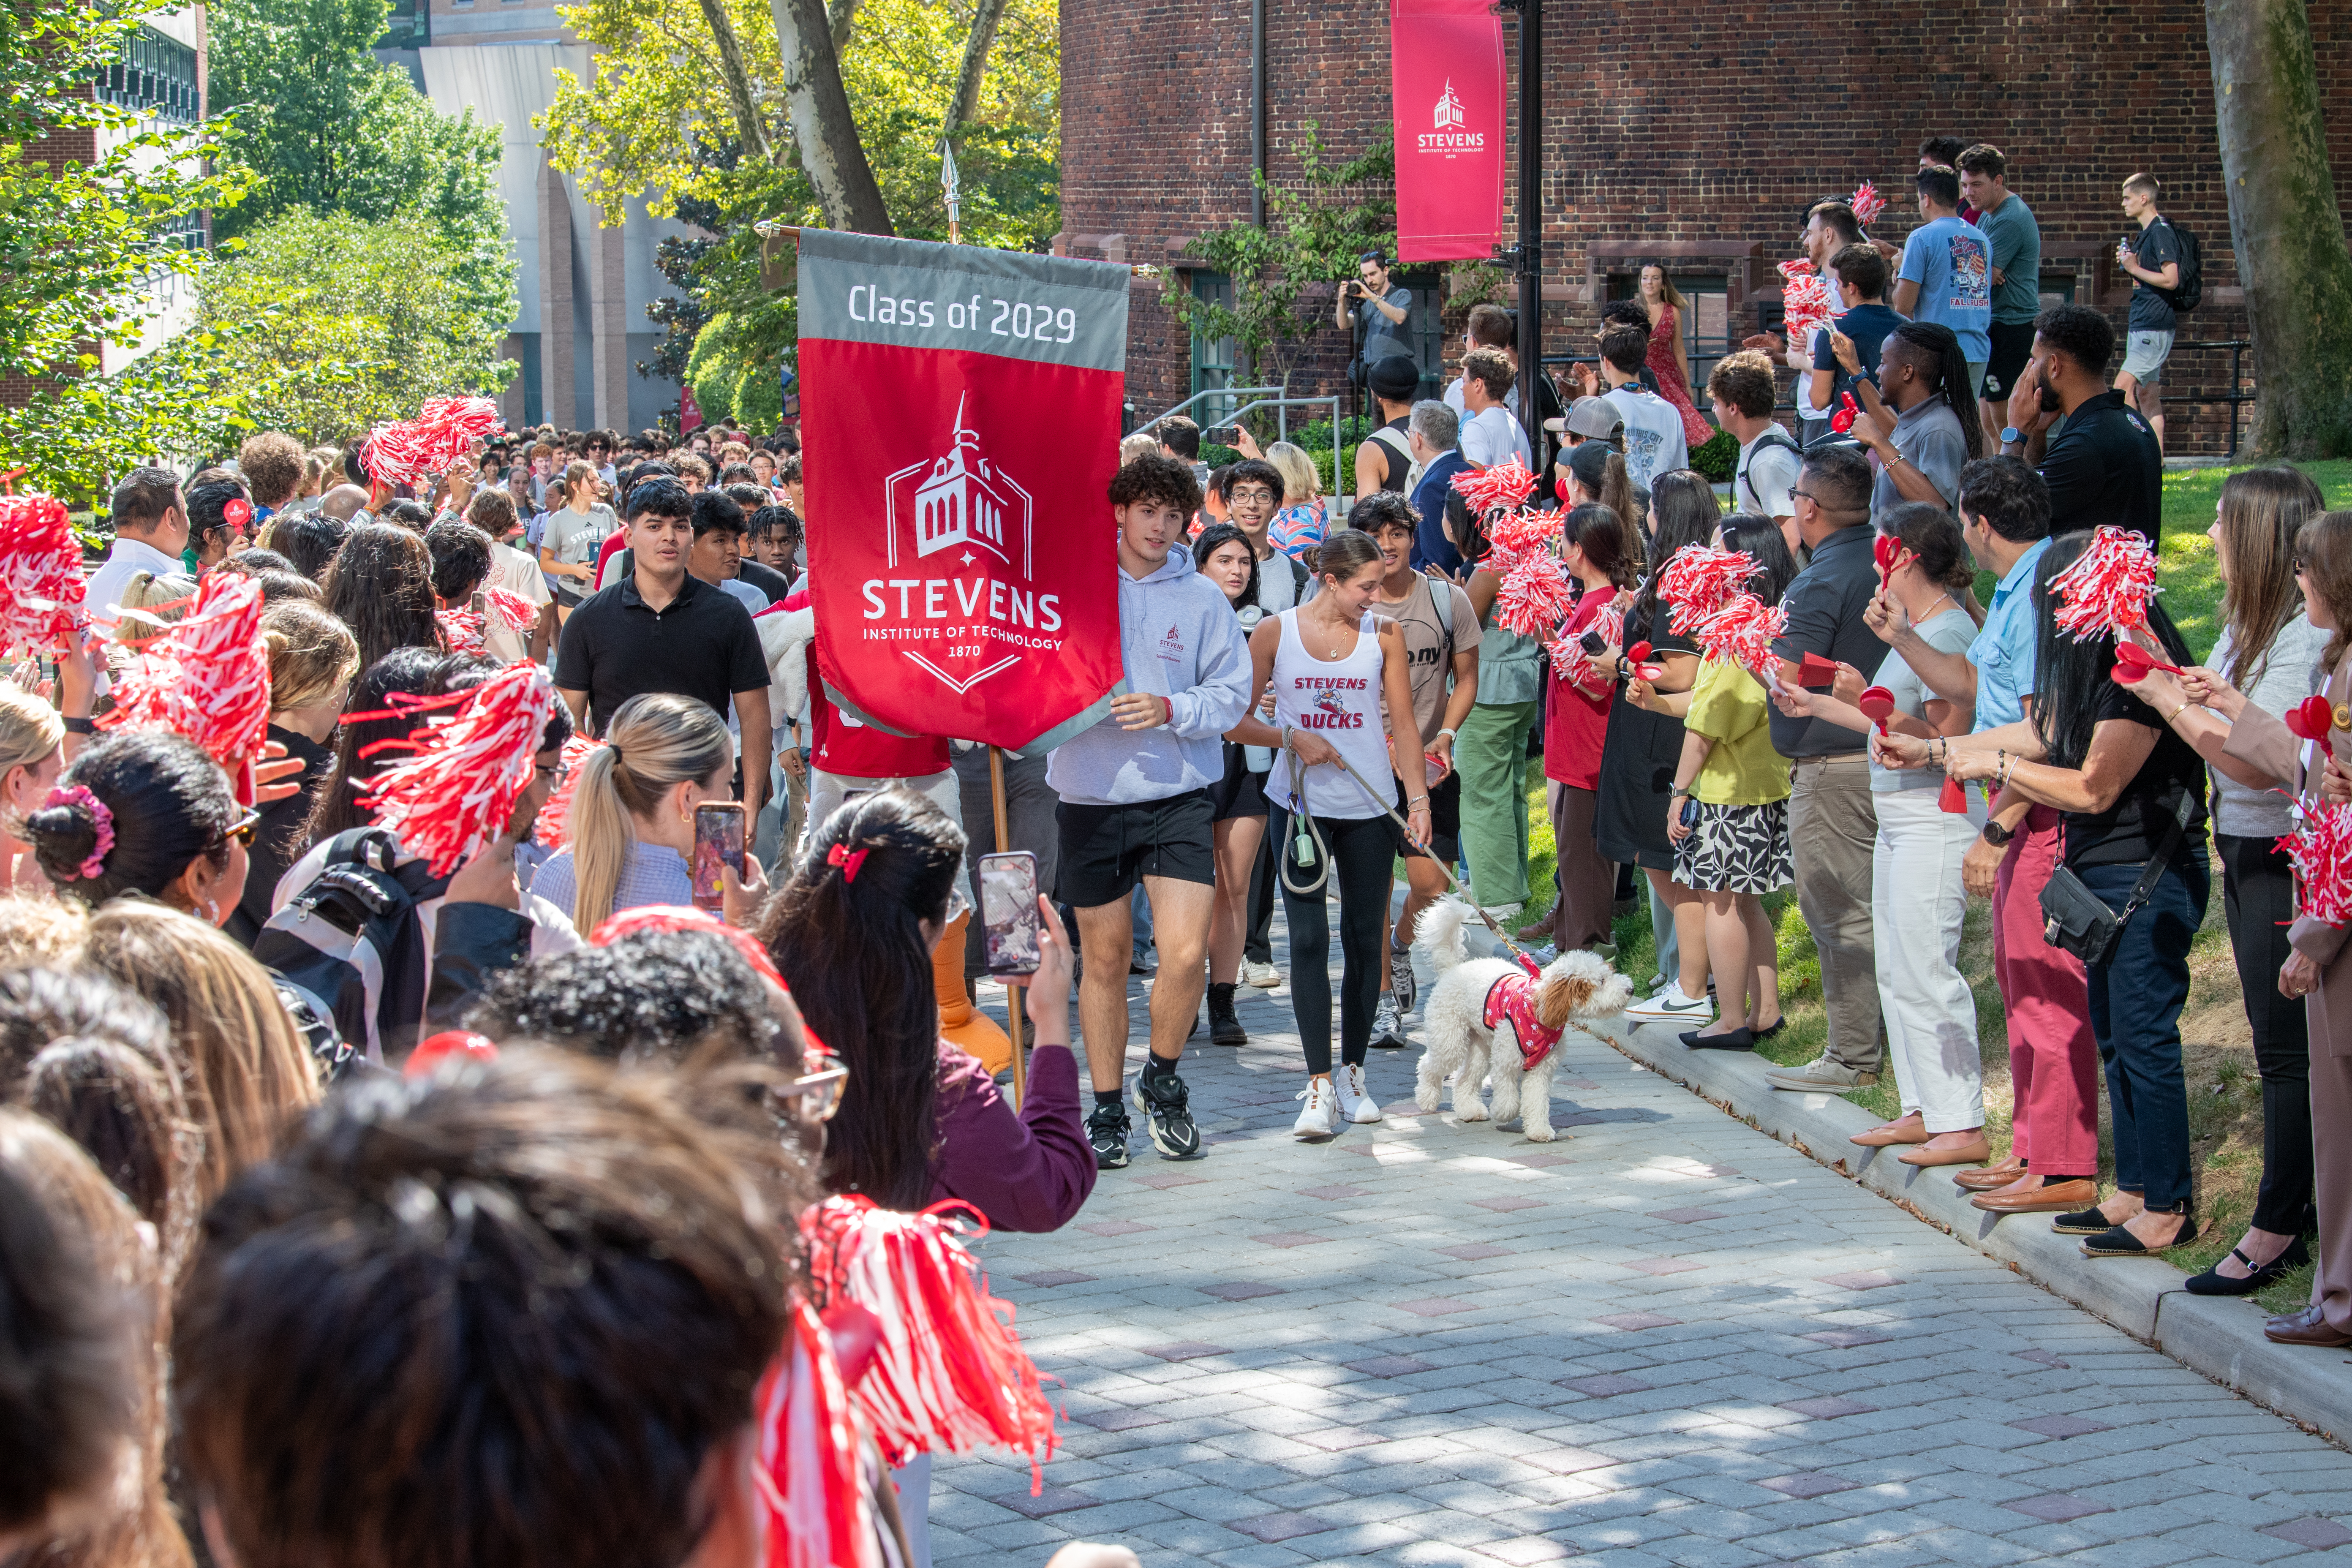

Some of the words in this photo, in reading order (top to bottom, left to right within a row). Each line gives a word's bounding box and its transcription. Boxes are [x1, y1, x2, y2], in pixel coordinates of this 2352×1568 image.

[1418, 133, 1484, 147] STEVENS
[1950, 297, 1971, 306] FALL
[1971, 298, 1989, 307] RUSH
[849, 284, 934, 328] Class
[948, 294, 981, 331] of
[991, 299, 1076, 343] 2029
[1636, 429, 1649, 439] THIS
[1650, 433, 1664, 444] CITY
[570, 528, 608, 544] STEVENS
[862, 577, 1062, 632] STEVENS
[864, 627, 940, 640] INSTITUTE
[947, 626, 966, 638] OF
[972, 625, 1062, 651] TECHNOLOGY
[1160, 640, 1184, 650] STEVENS
[948, 645, 980, 657] 1870
[1295, 677, 1368, 690] STEVENS
[1300, 713, 1364, 730] DUCKS
